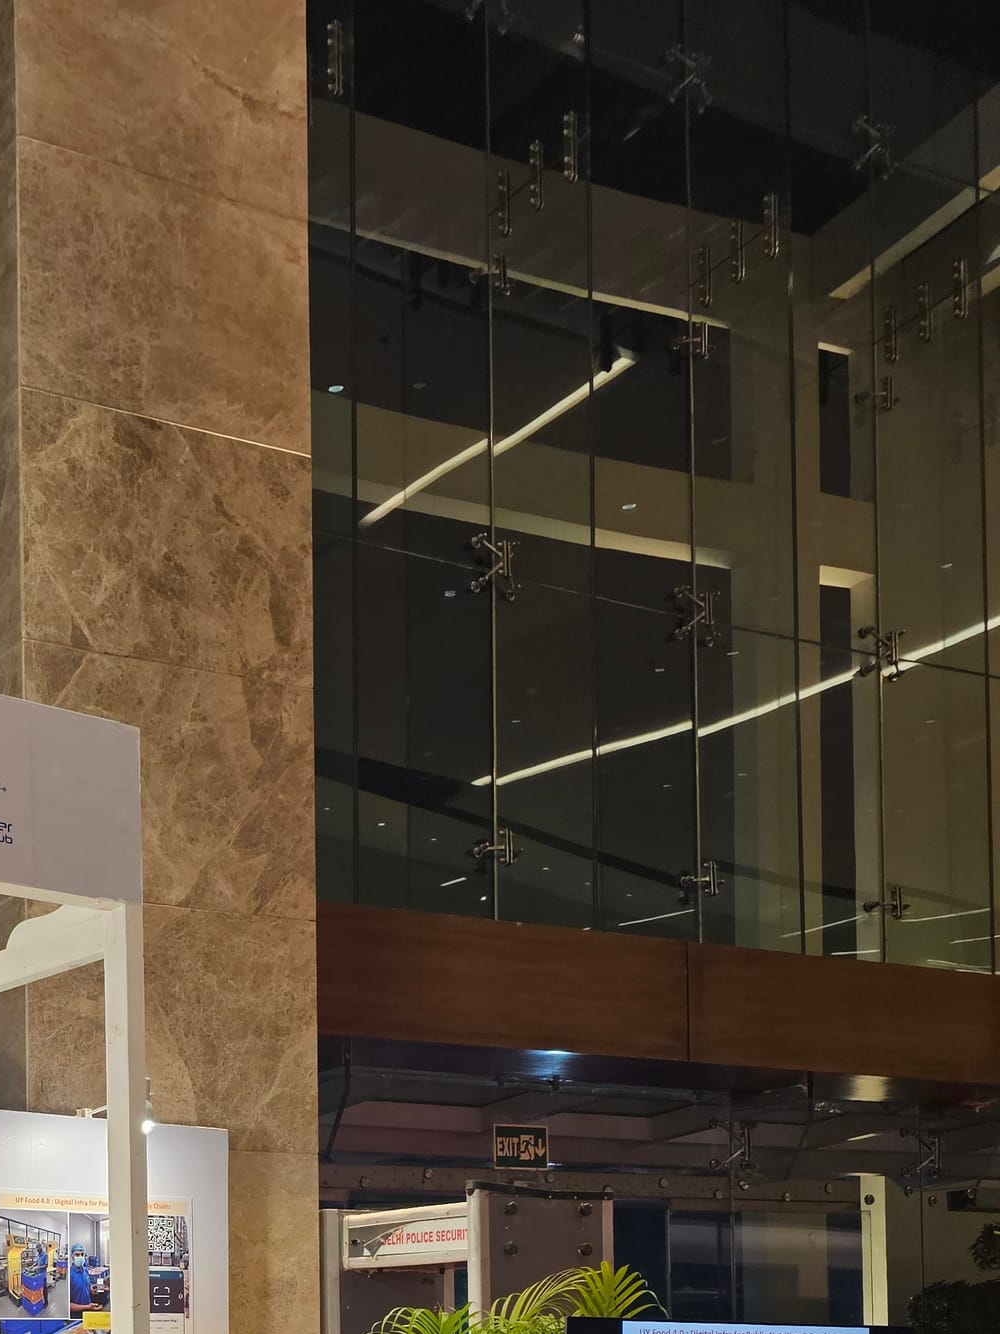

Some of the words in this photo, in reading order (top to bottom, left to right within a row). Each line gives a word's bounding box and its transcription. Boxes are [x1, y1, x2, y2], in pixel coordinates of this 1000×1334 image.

[497, 1137, 519, 1157] EXIT
[55, 1198, 73, 1207] Digital
[406, 1231, 434, 1244] POLICE
[435, 1229, 468, 1242] SECURI
